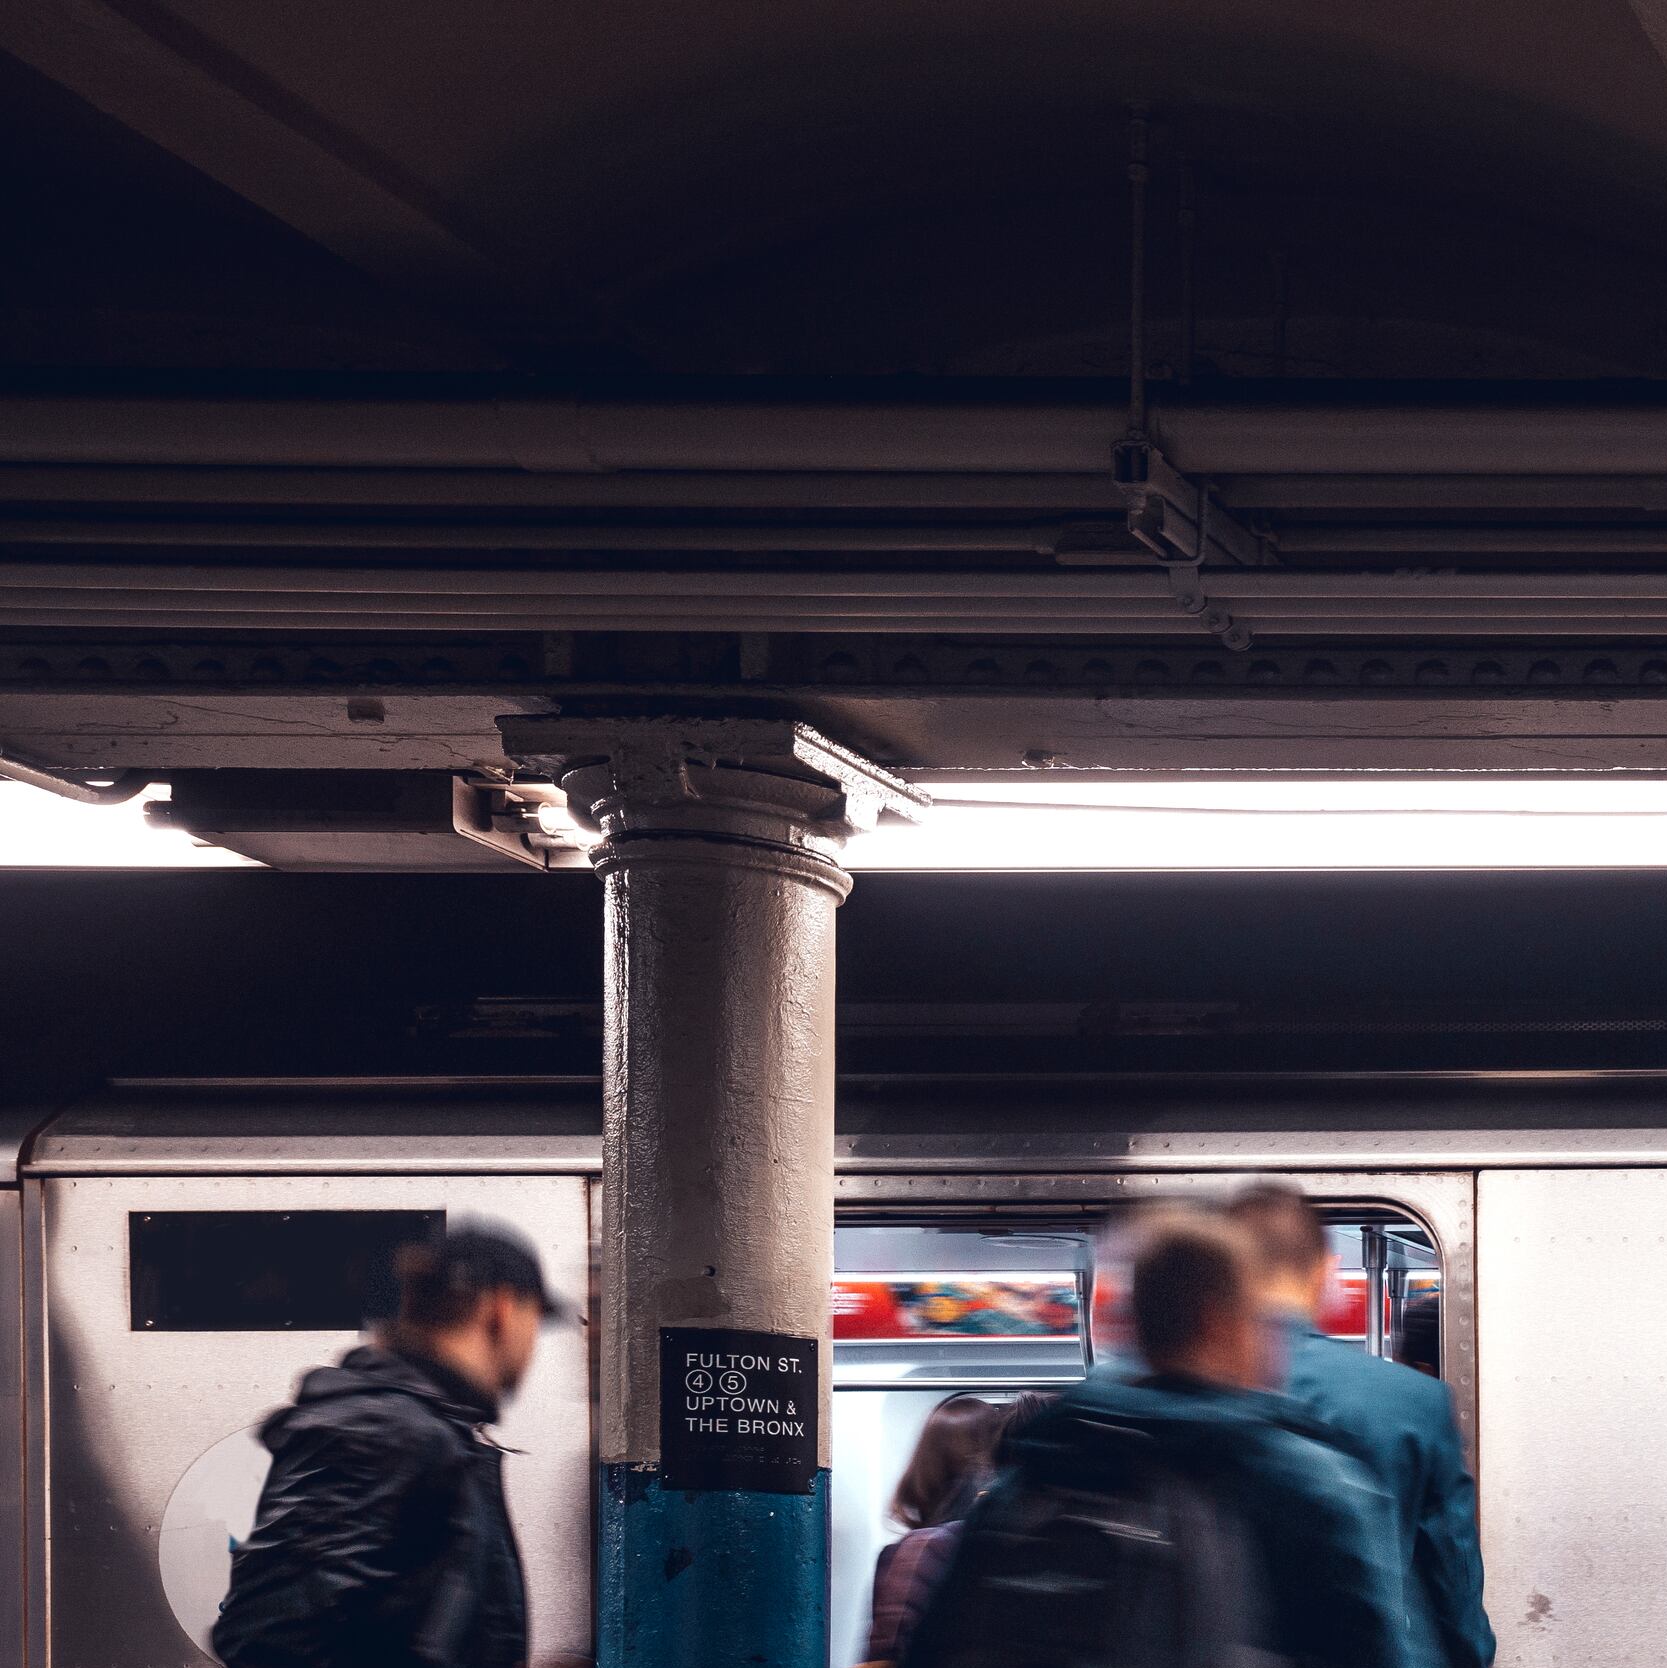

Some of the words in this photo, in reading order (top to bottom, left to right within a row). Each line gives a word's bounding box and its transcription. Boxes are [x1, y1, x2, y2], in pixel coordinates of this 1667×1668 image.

[686, 1353, 770, 1371] FULTON
[778, 1357, 802, 1374] ST.
[686, 1396, 779, 1414] UPTOWN
[786, 1400, 797, 1415] &
[685, 1417, 729, 1433] THE
[737, 1419, 805, 1437] BRONX
